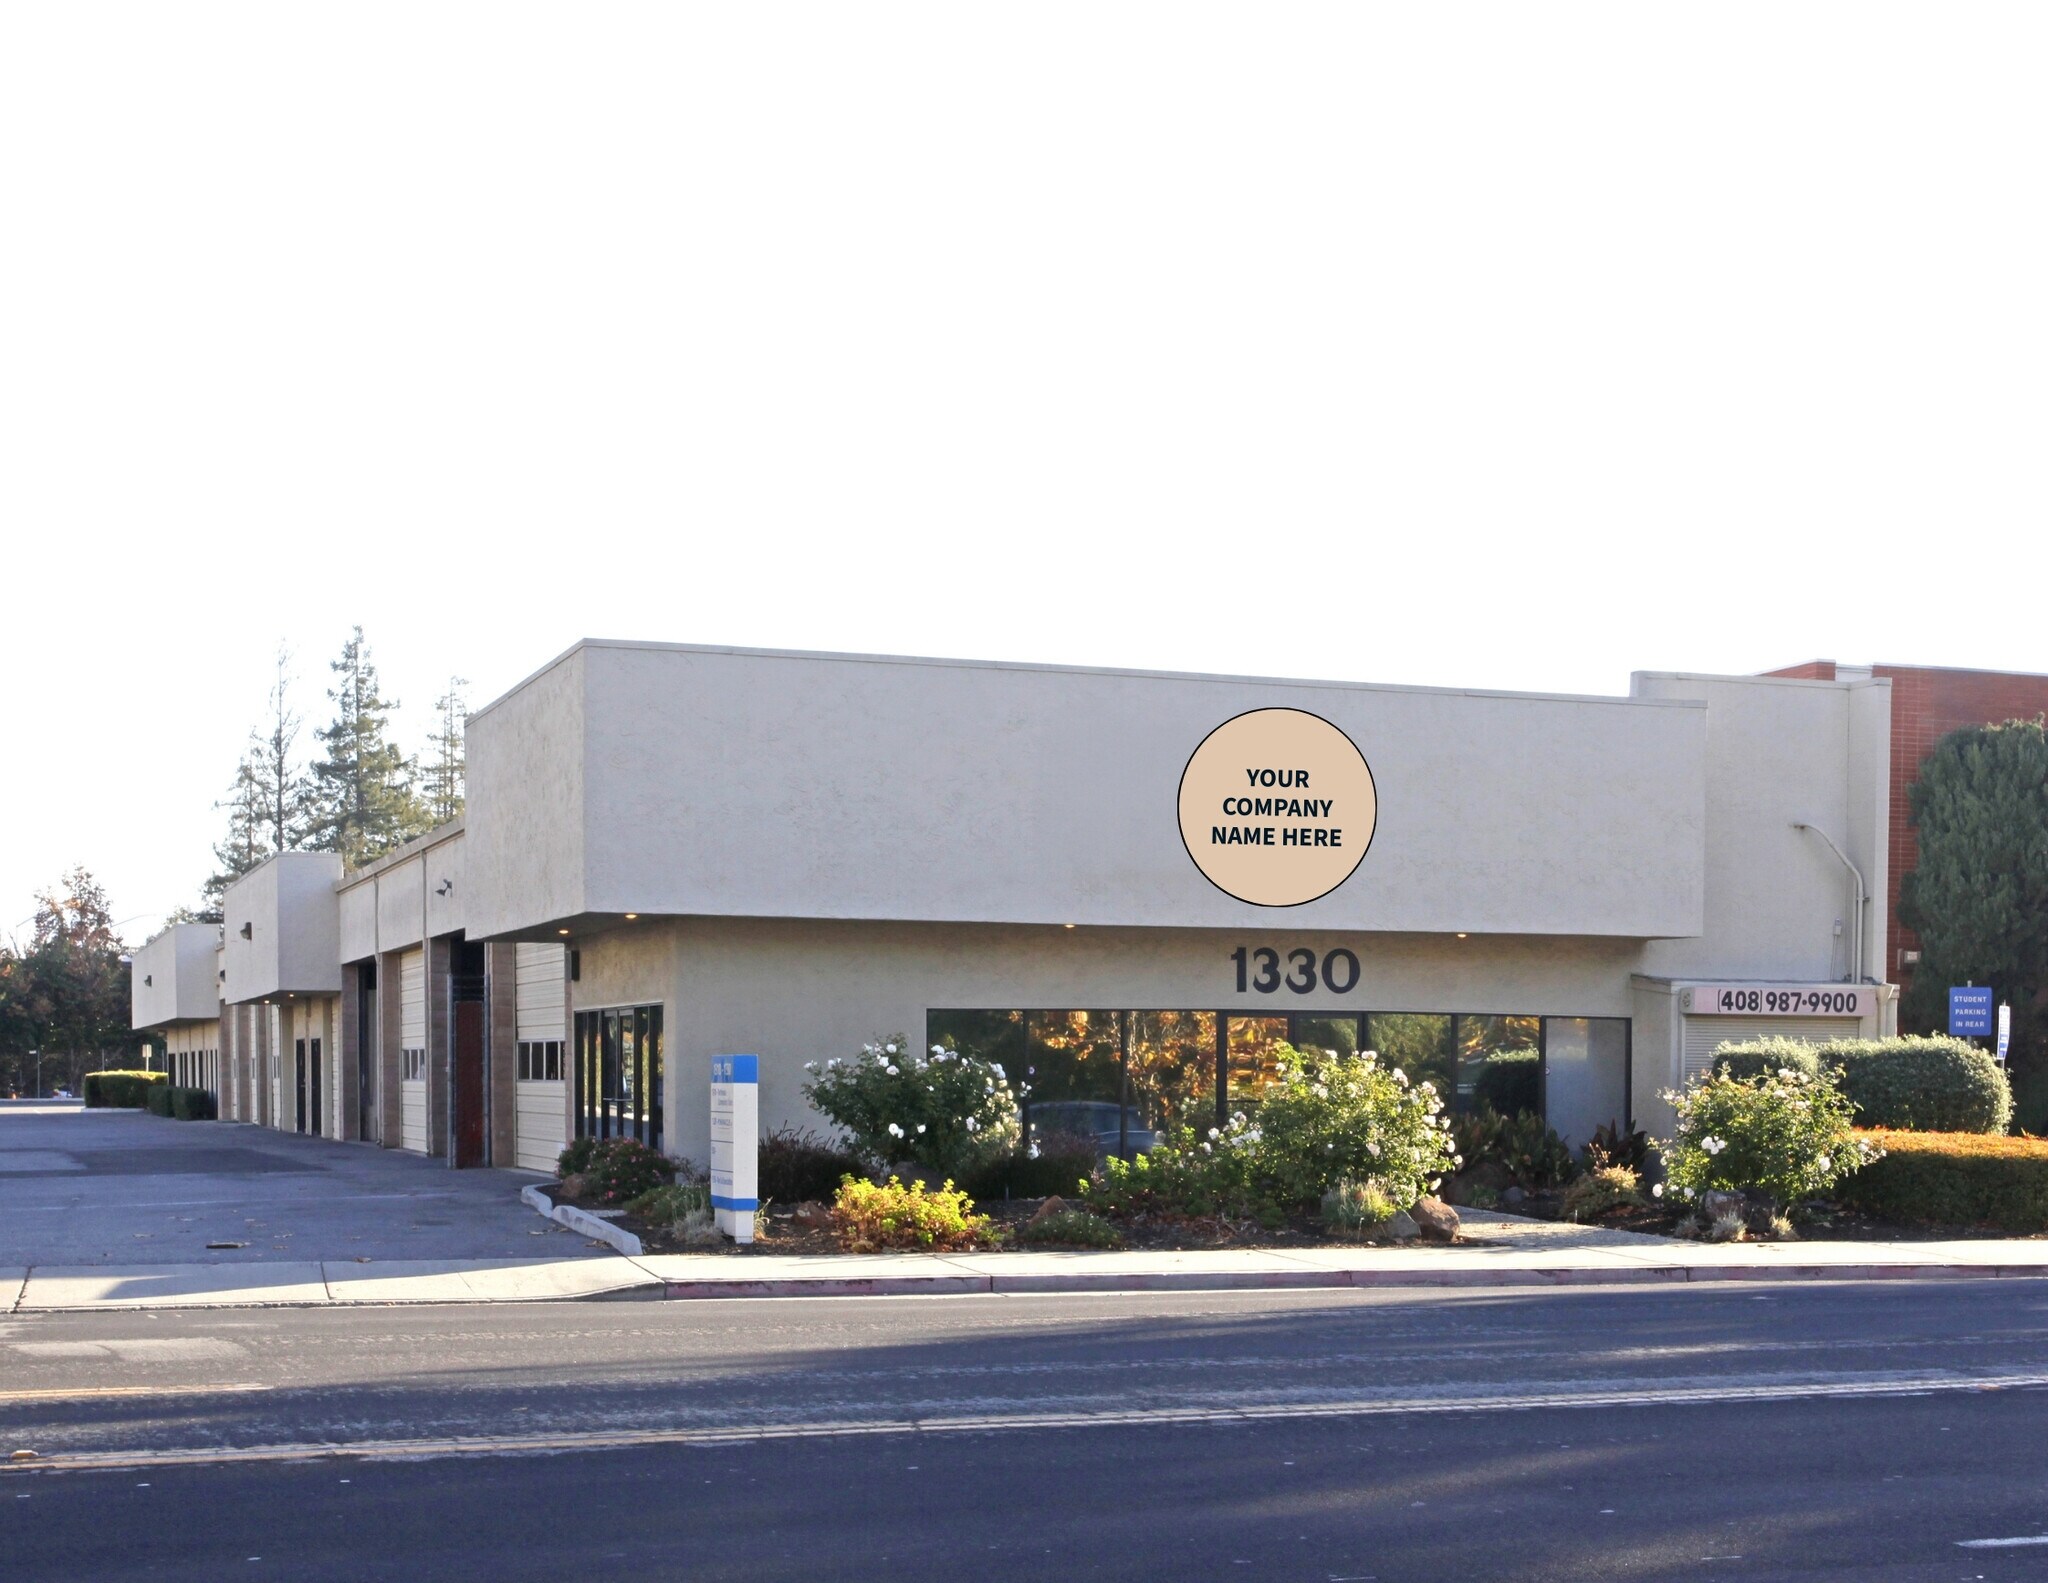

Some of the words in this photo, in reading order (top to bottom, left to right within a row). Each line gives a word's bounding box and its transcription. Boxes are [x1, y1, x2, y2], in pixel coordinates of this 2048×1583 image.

[1230, 946, 1361, 995] 1330
[1953, 995, 1987, 1003] STUDENT
[1955, 1008, 1987, 1016] PARKING
